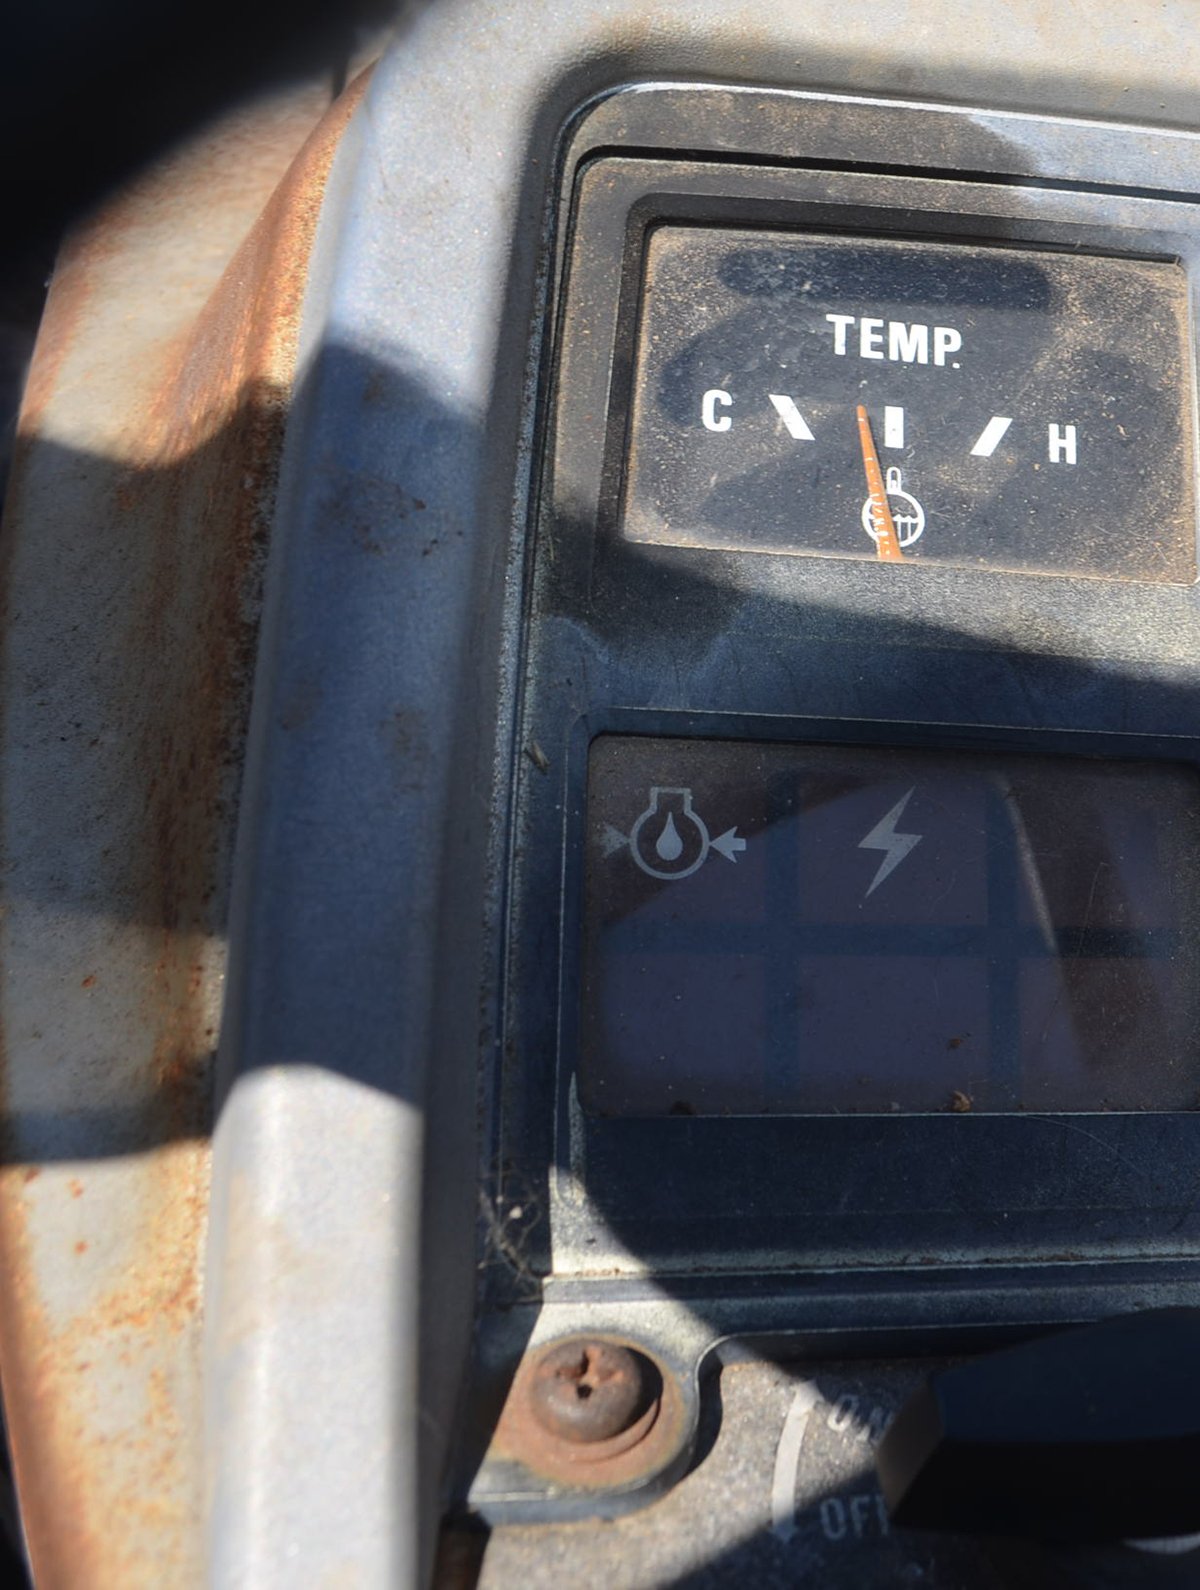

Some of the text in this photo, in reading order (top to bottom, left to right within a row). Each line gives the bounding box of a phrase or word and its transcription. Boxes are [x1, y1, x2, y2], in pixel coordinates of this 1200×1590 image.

[825, 313, 963, 369] TEMP.
[702, 389, 733, 433] C
[1047, 423, 1078, 465] H
